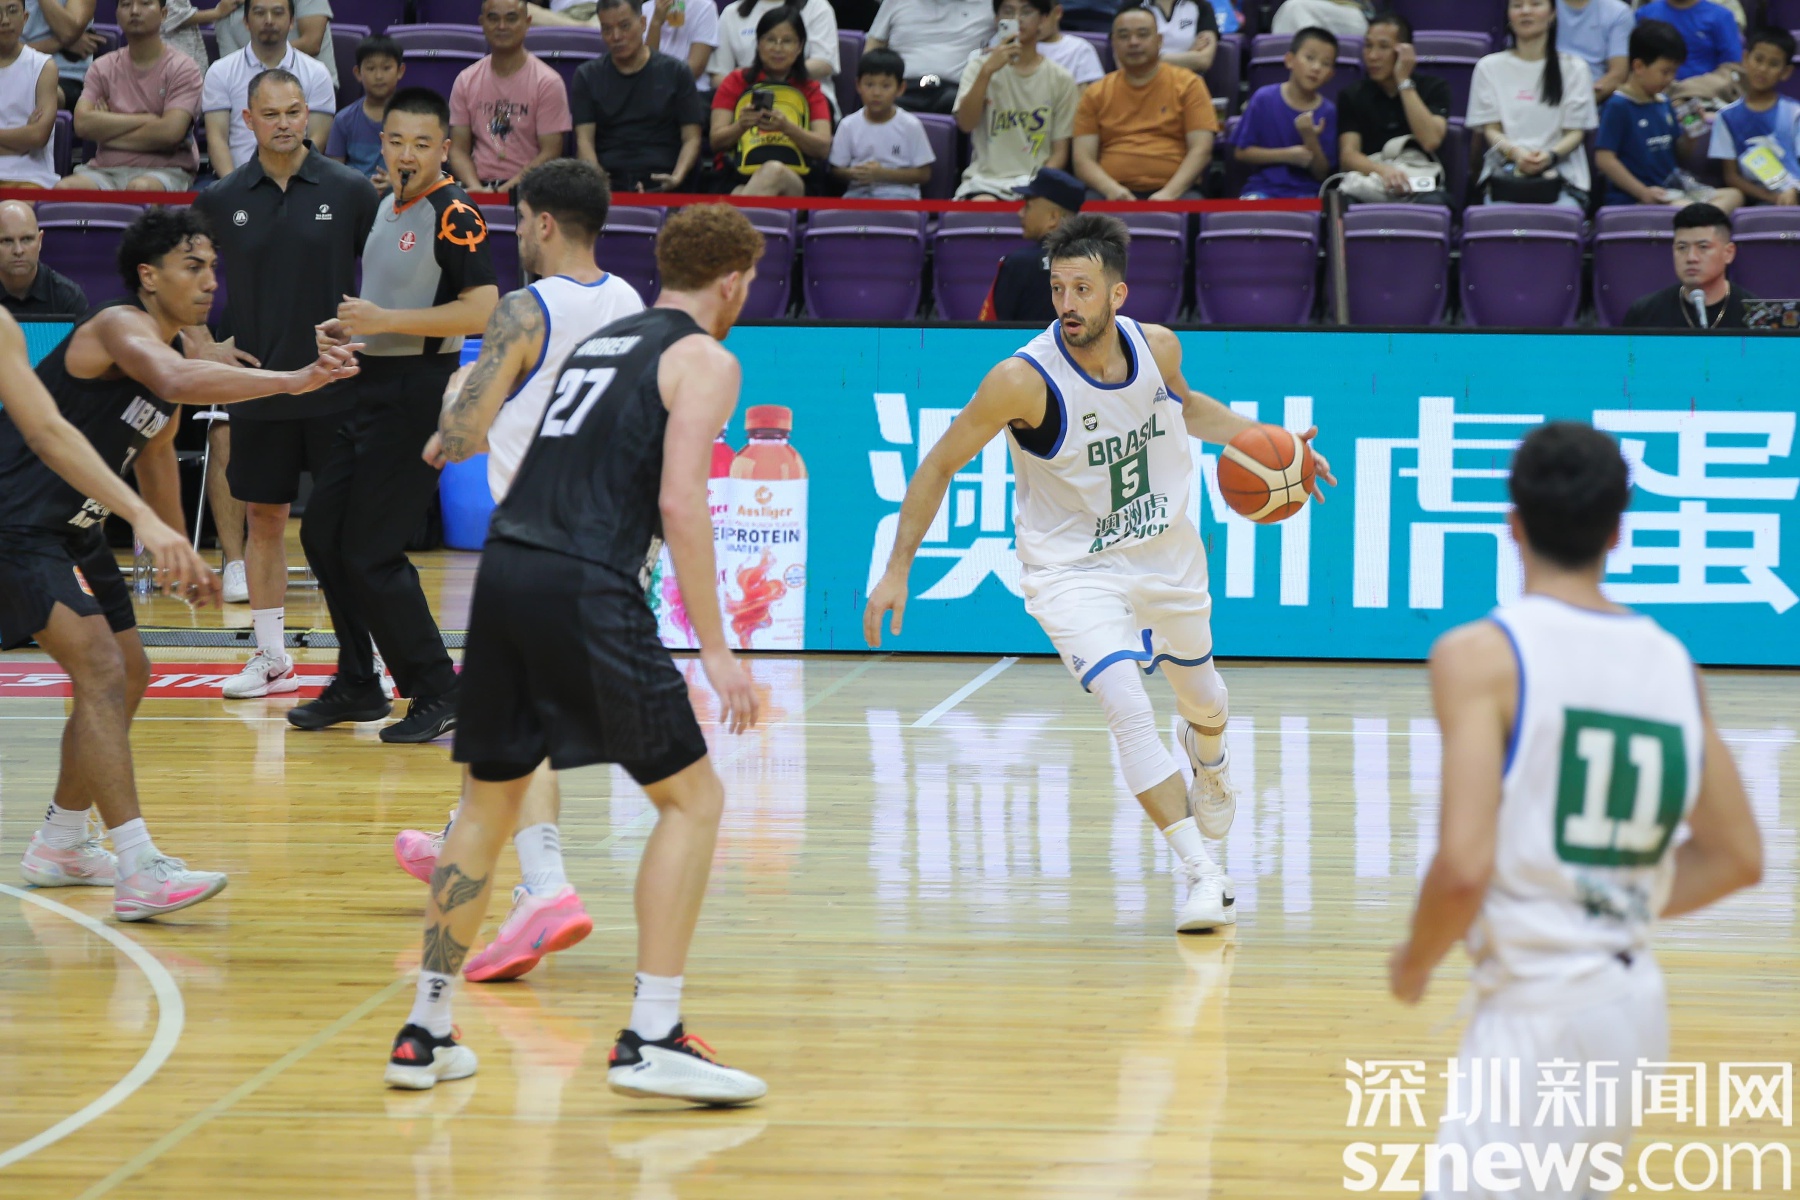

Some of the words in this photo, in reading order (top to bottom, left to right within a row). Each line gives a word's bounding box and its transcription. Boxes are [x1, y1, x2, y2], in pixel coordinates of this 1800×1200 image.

[540, 367, 618, 437] 27
[1087, 412, 1166, 467] BRASIL
[1120, 458, 1141, 499] 5
[727, 527, 801, 544] PROTEIN
[1094, 492, 1169, 538] 澳洲虎
[1562, 726, 1665, 853] 11
